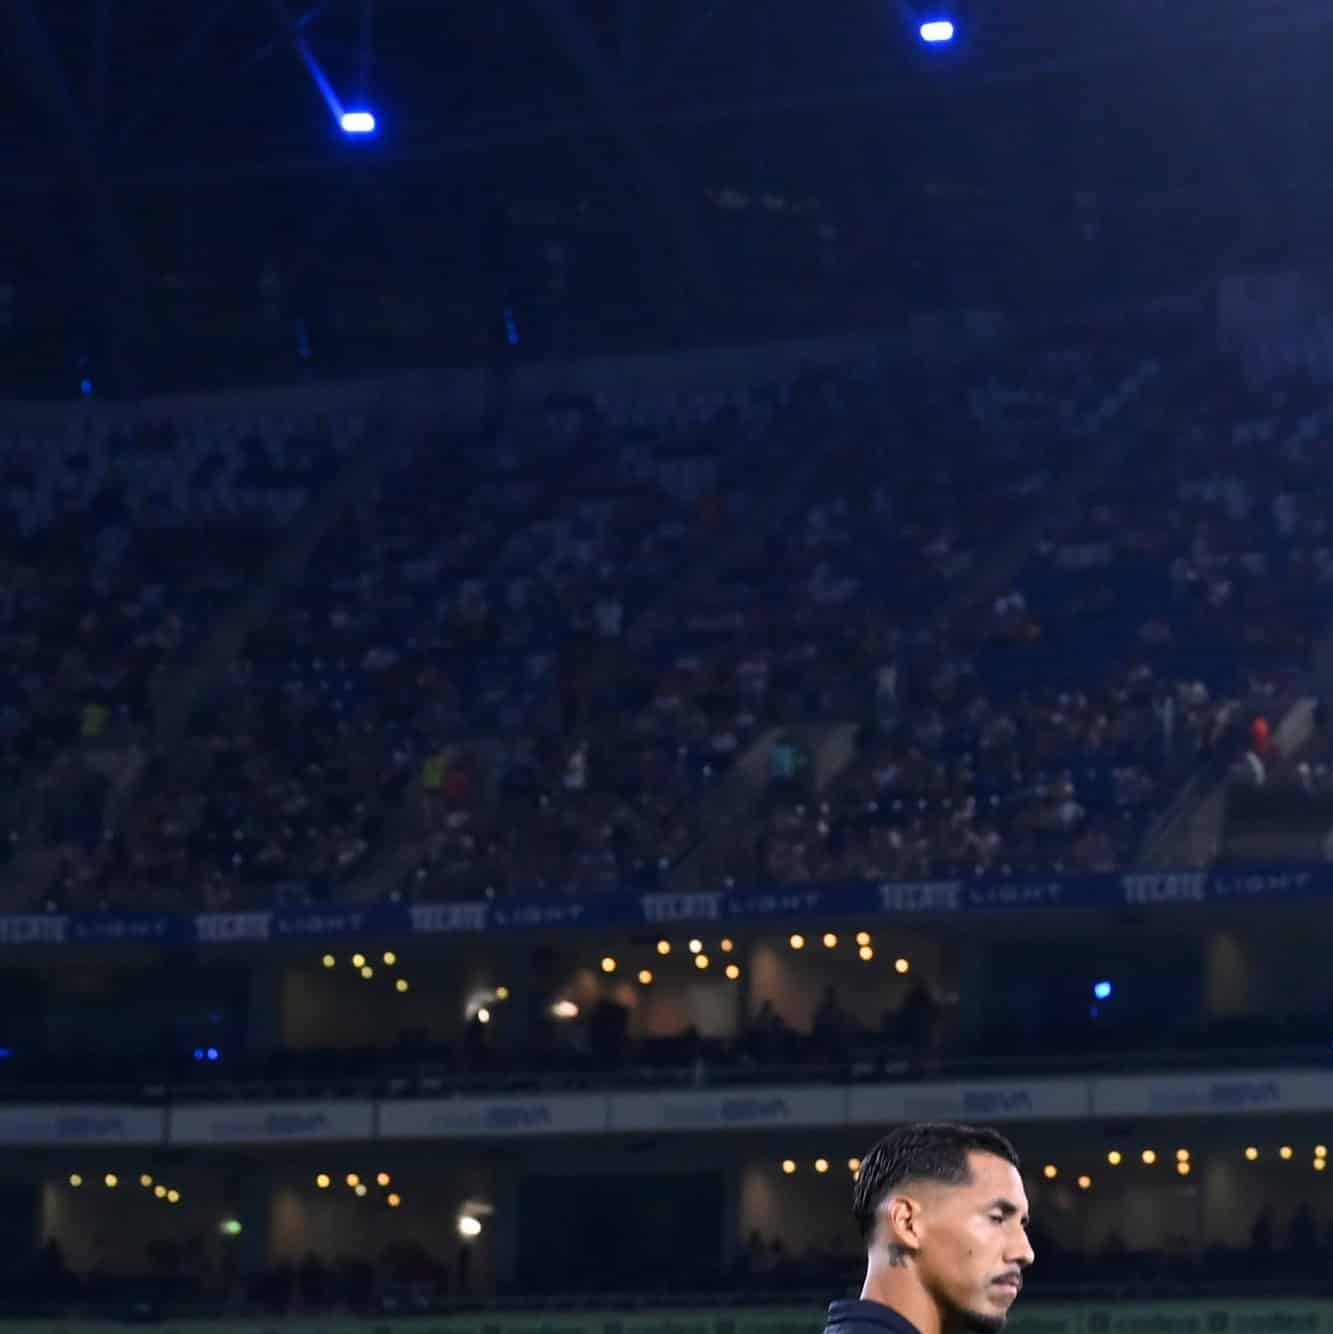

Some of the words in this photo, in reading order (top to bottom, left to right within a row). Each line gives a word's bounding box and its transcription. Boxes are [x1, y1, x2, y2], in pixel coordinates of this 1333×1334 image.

[878, 879, 960, 912] TECATE
[1119, 871, 1205, 904] TECATE
[408, 900, 488, 932] TECATE
[639, 891, 721, 923] TECATE
[0, 914, 68, 943] ECATE
[194, 911, 272, 942] TECATE
